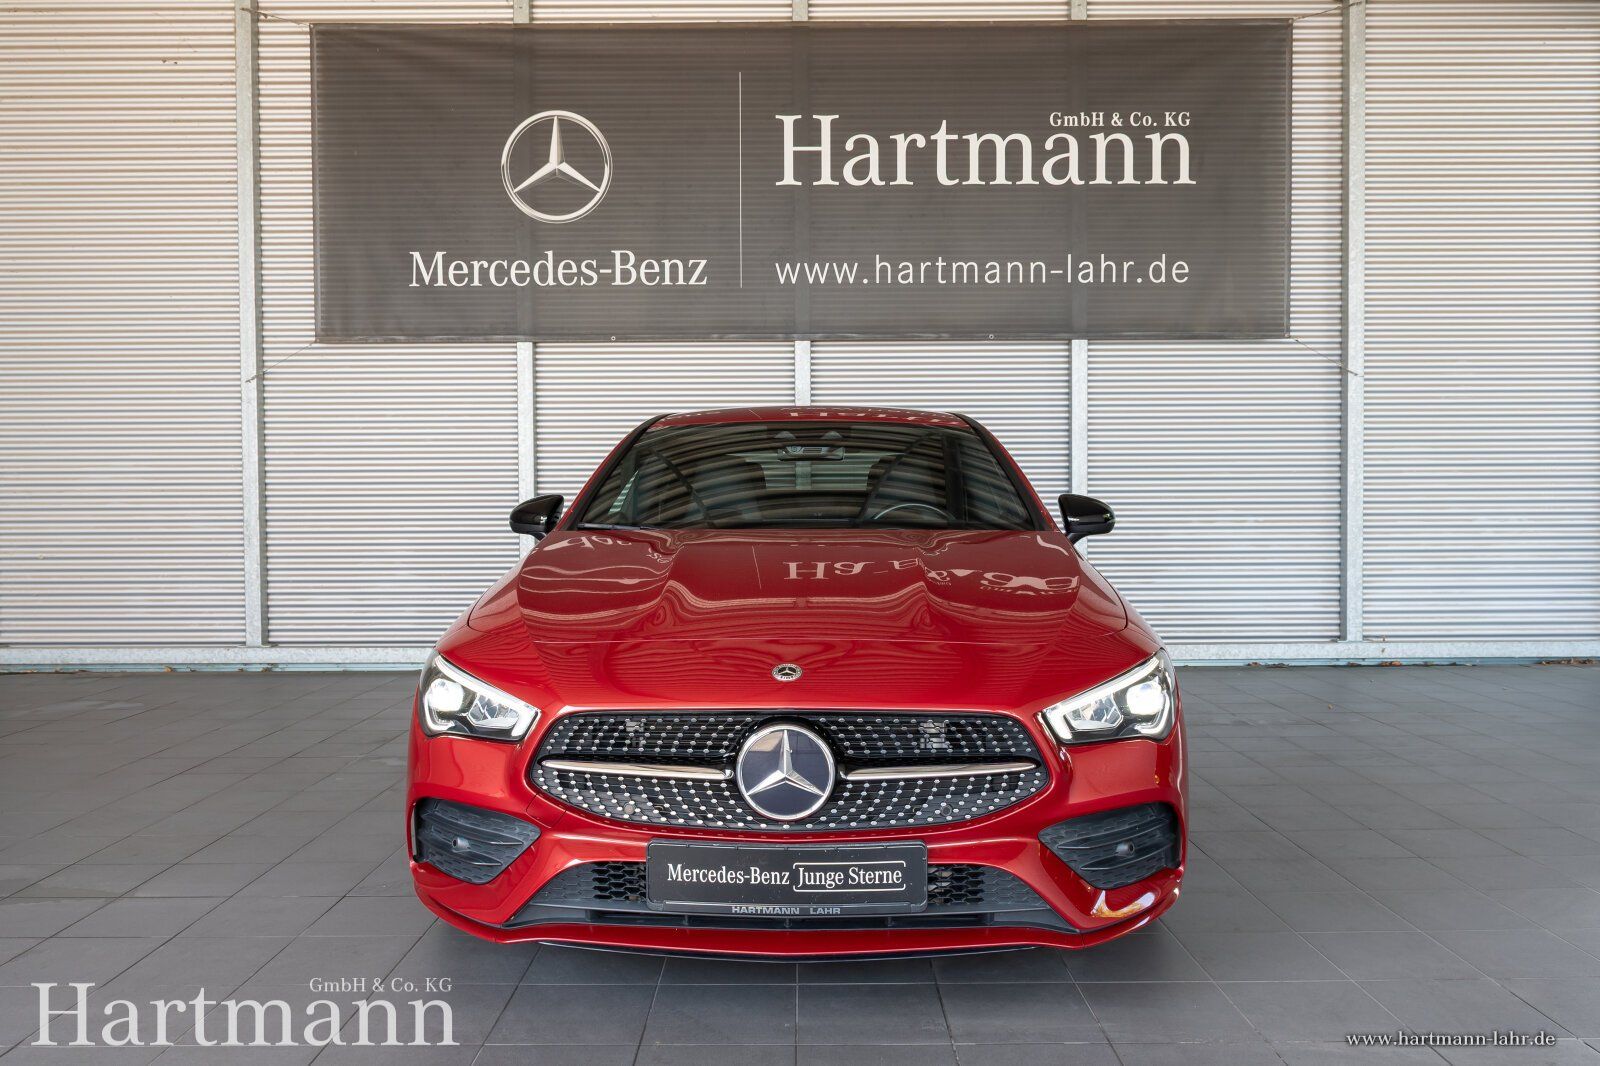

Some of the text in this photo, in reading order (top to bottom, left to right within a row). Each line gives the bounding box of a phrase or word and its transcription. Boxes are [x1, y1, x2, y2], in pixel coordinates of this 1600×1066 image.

[1049, 111, 1191, 127] GmbH & Co. KG
[775, 114, 1197, 187] Hartmann
[409, 250, 708, 287] Mercedes-Benz
[775, 254, 1190, 284] www.hartmann-lahr.de
[667, 863, 902, 889] Mercedes-Benz Junge Sterne
[731, 905, 841, 915] HARTMANN LAHR
